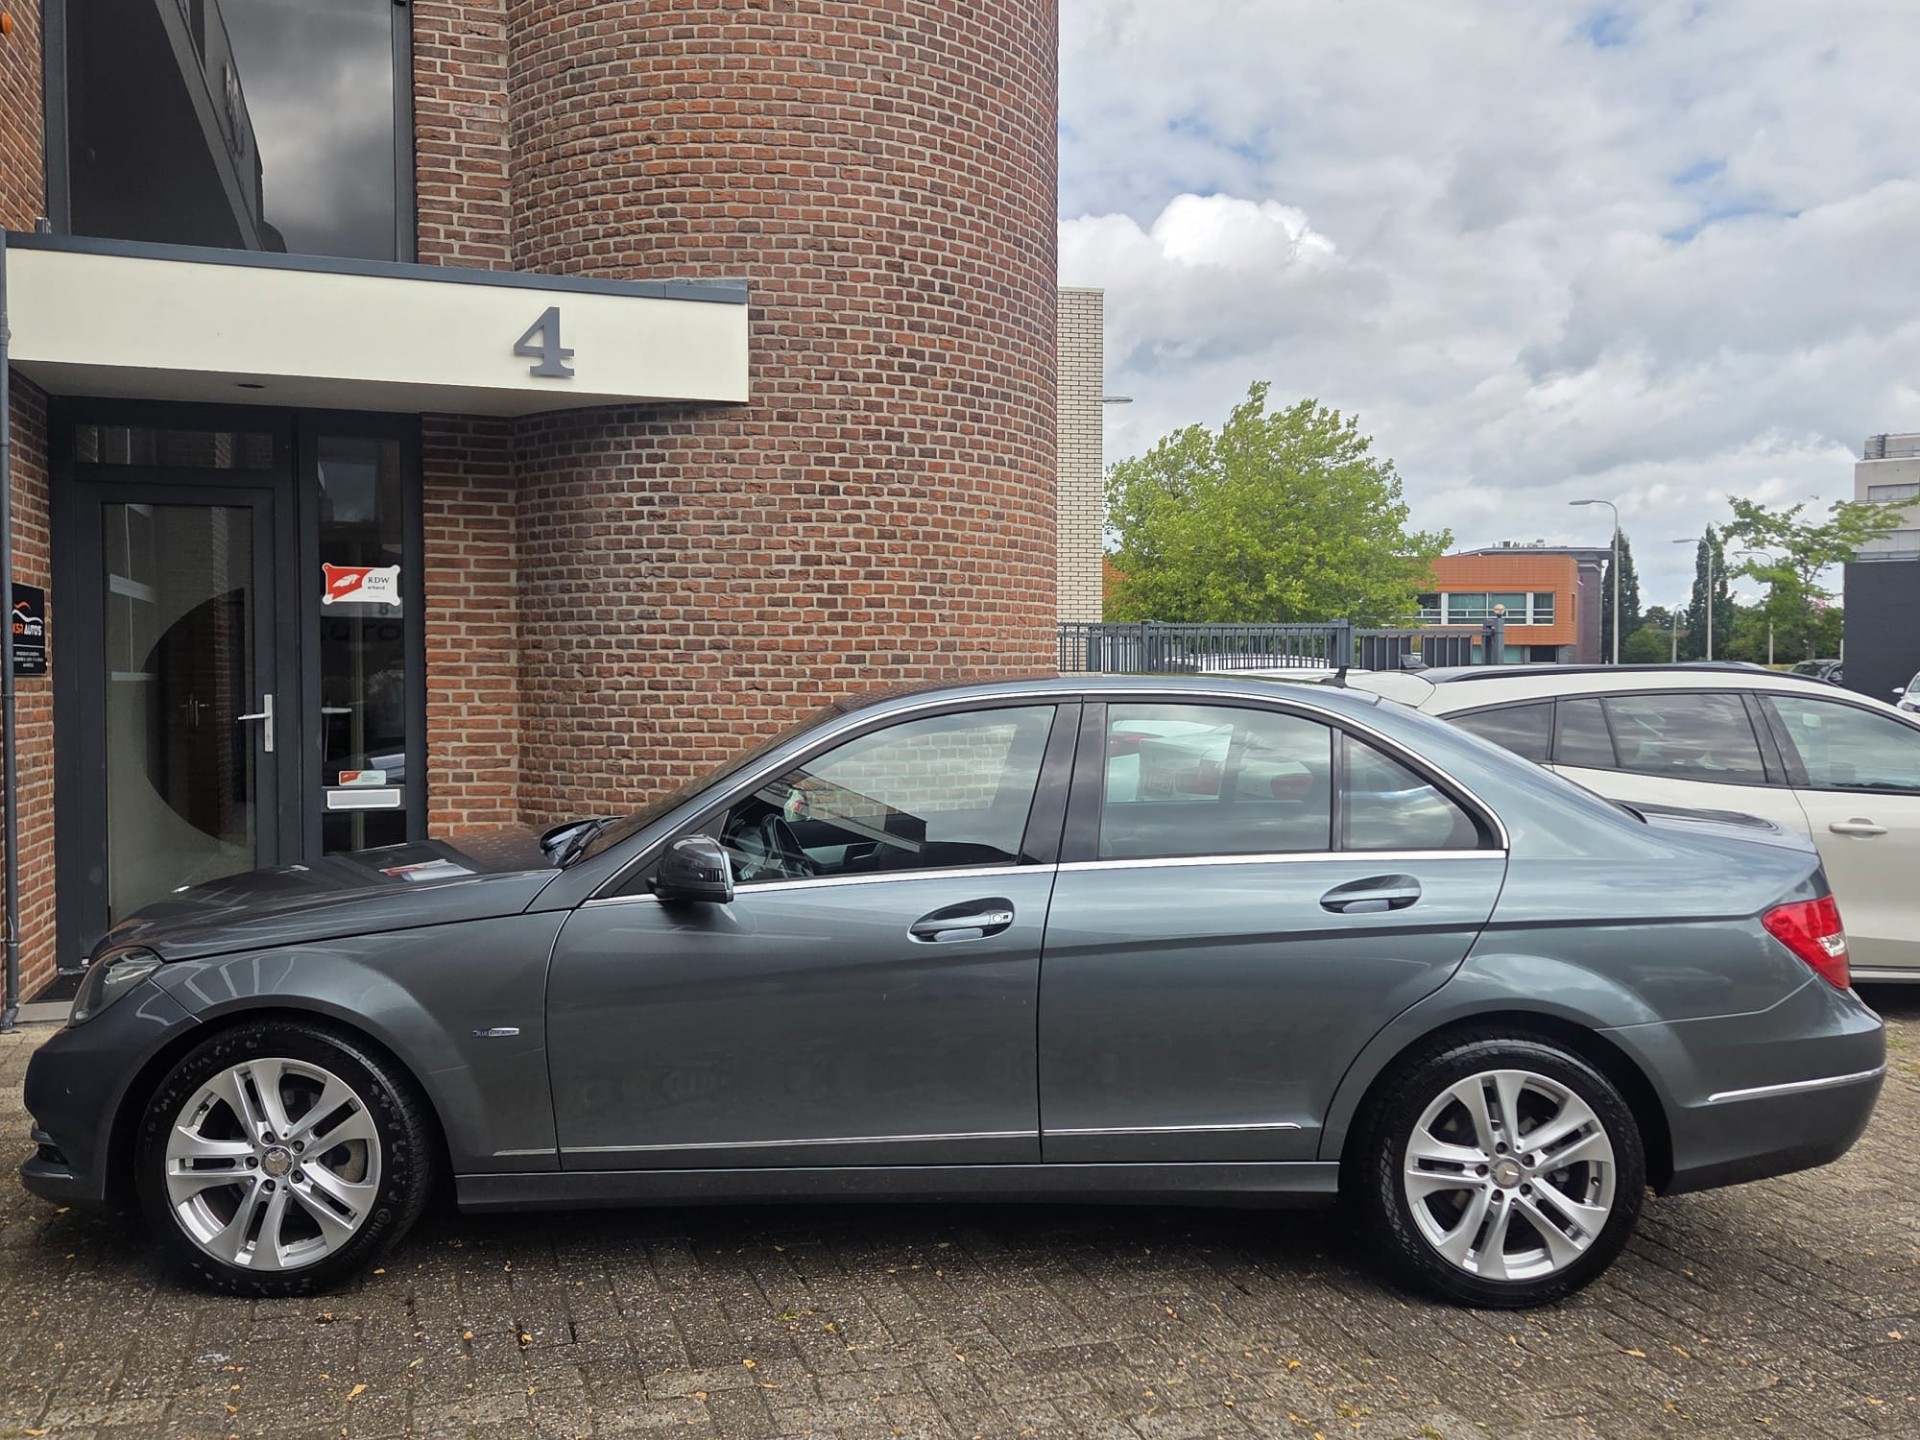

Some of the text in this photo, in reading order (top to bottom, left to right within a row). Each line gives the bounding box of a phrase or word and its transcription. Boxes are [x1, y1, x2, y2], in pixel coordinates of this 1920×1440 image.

[513, 306, 575, 377] 4
[367, 576, 390, 584] RDW
[24, 623, 42, 636] AUTOS
